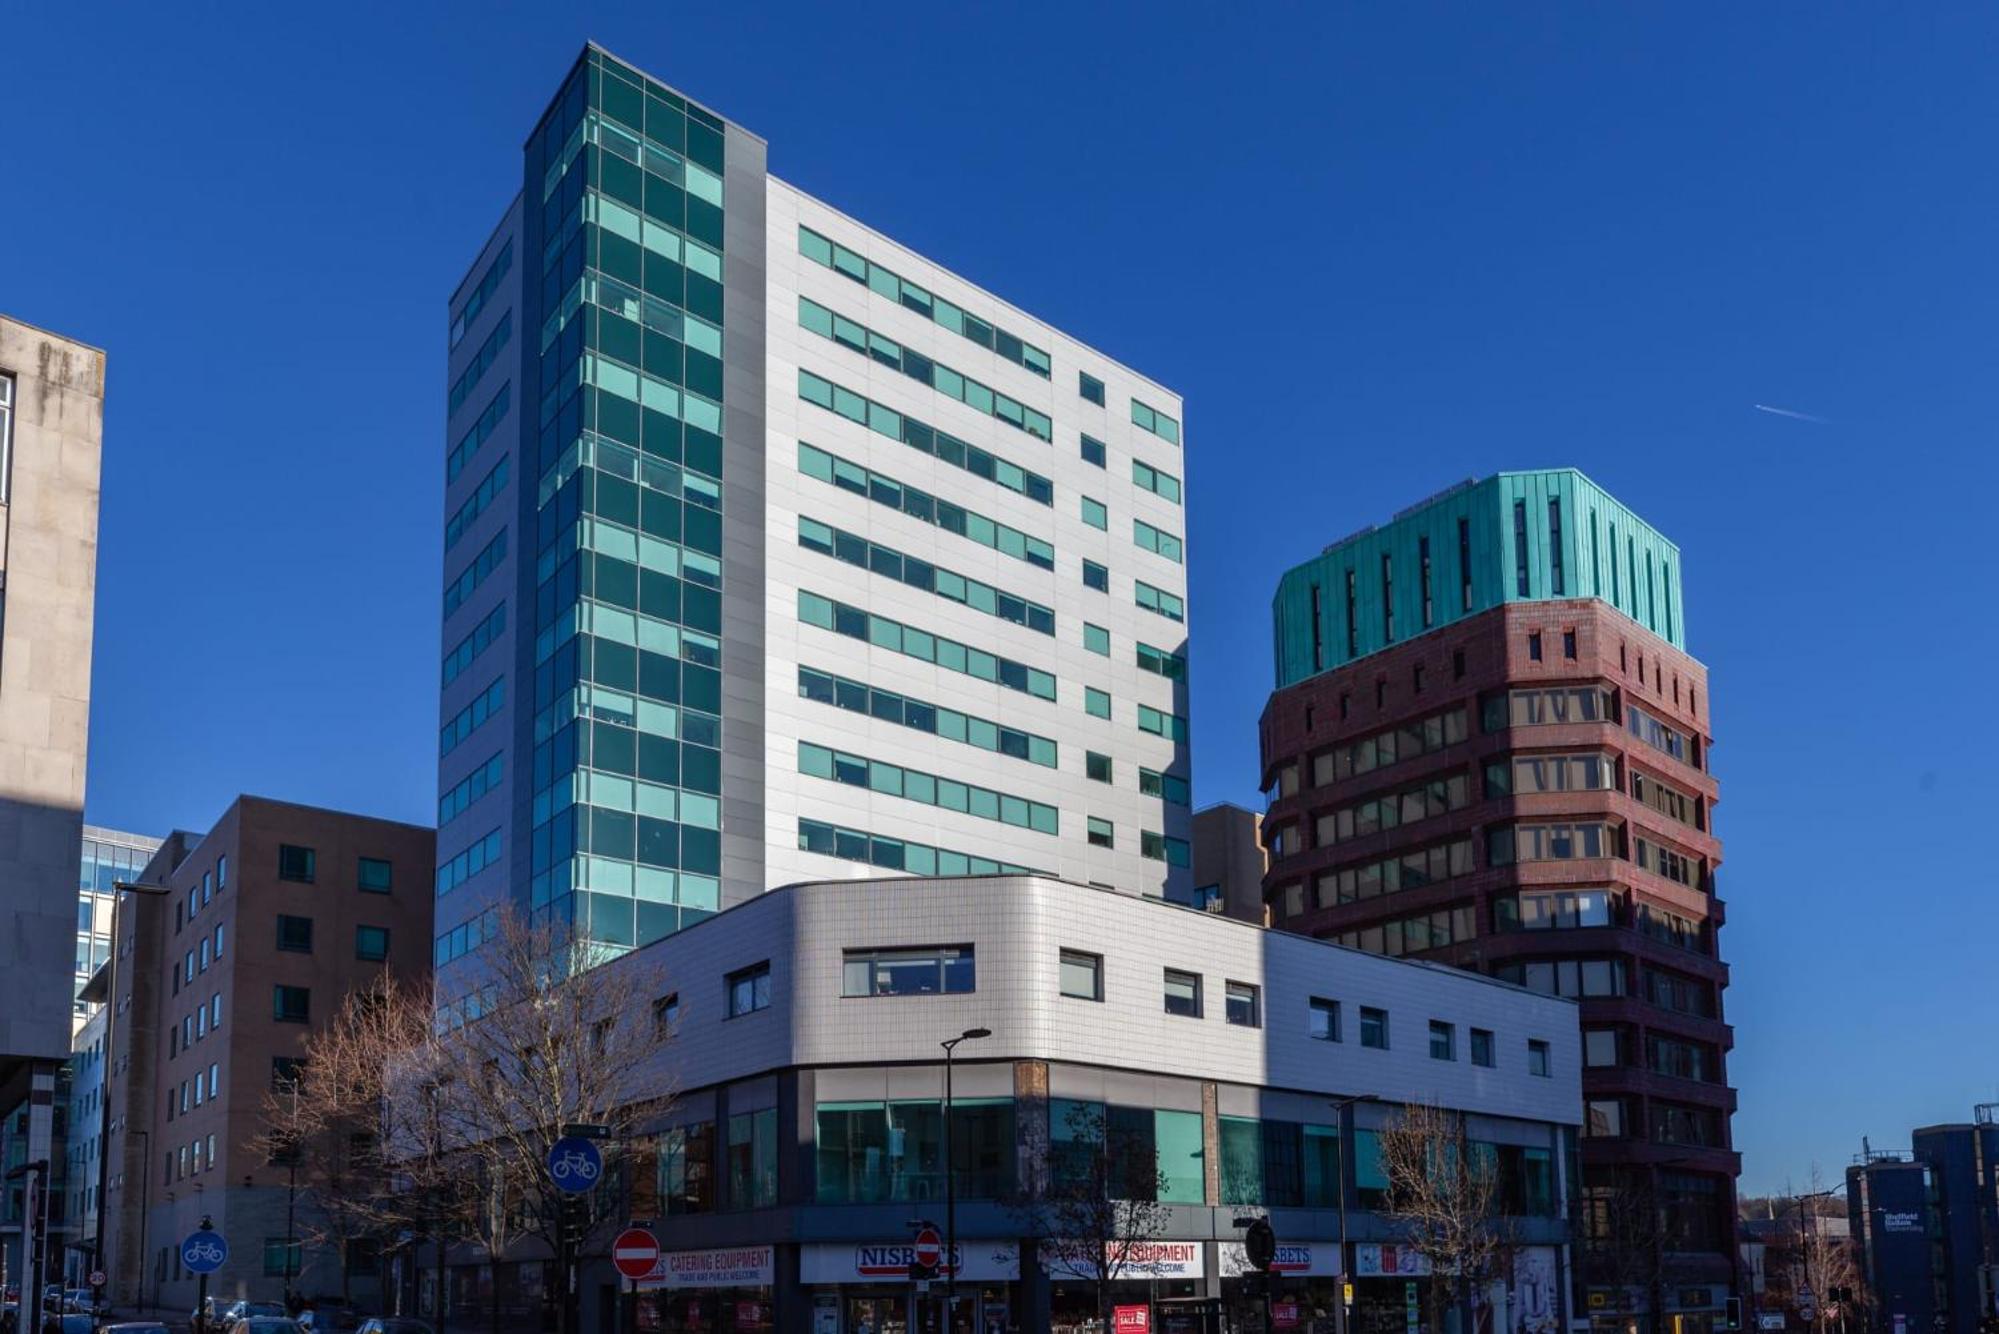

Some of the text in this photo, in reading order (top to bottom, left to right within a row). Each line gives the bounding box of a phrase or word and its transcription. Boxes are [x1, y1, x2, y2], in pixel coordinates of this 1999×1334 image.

[671, 1253, 712, 1272] CATERING
[715, 1250, 769, 1270] EQUIPMENT
[1130, 1243, 1194, 1262] EQUIPMENT
[1273, 1247, 1310, 1263] SBETS
